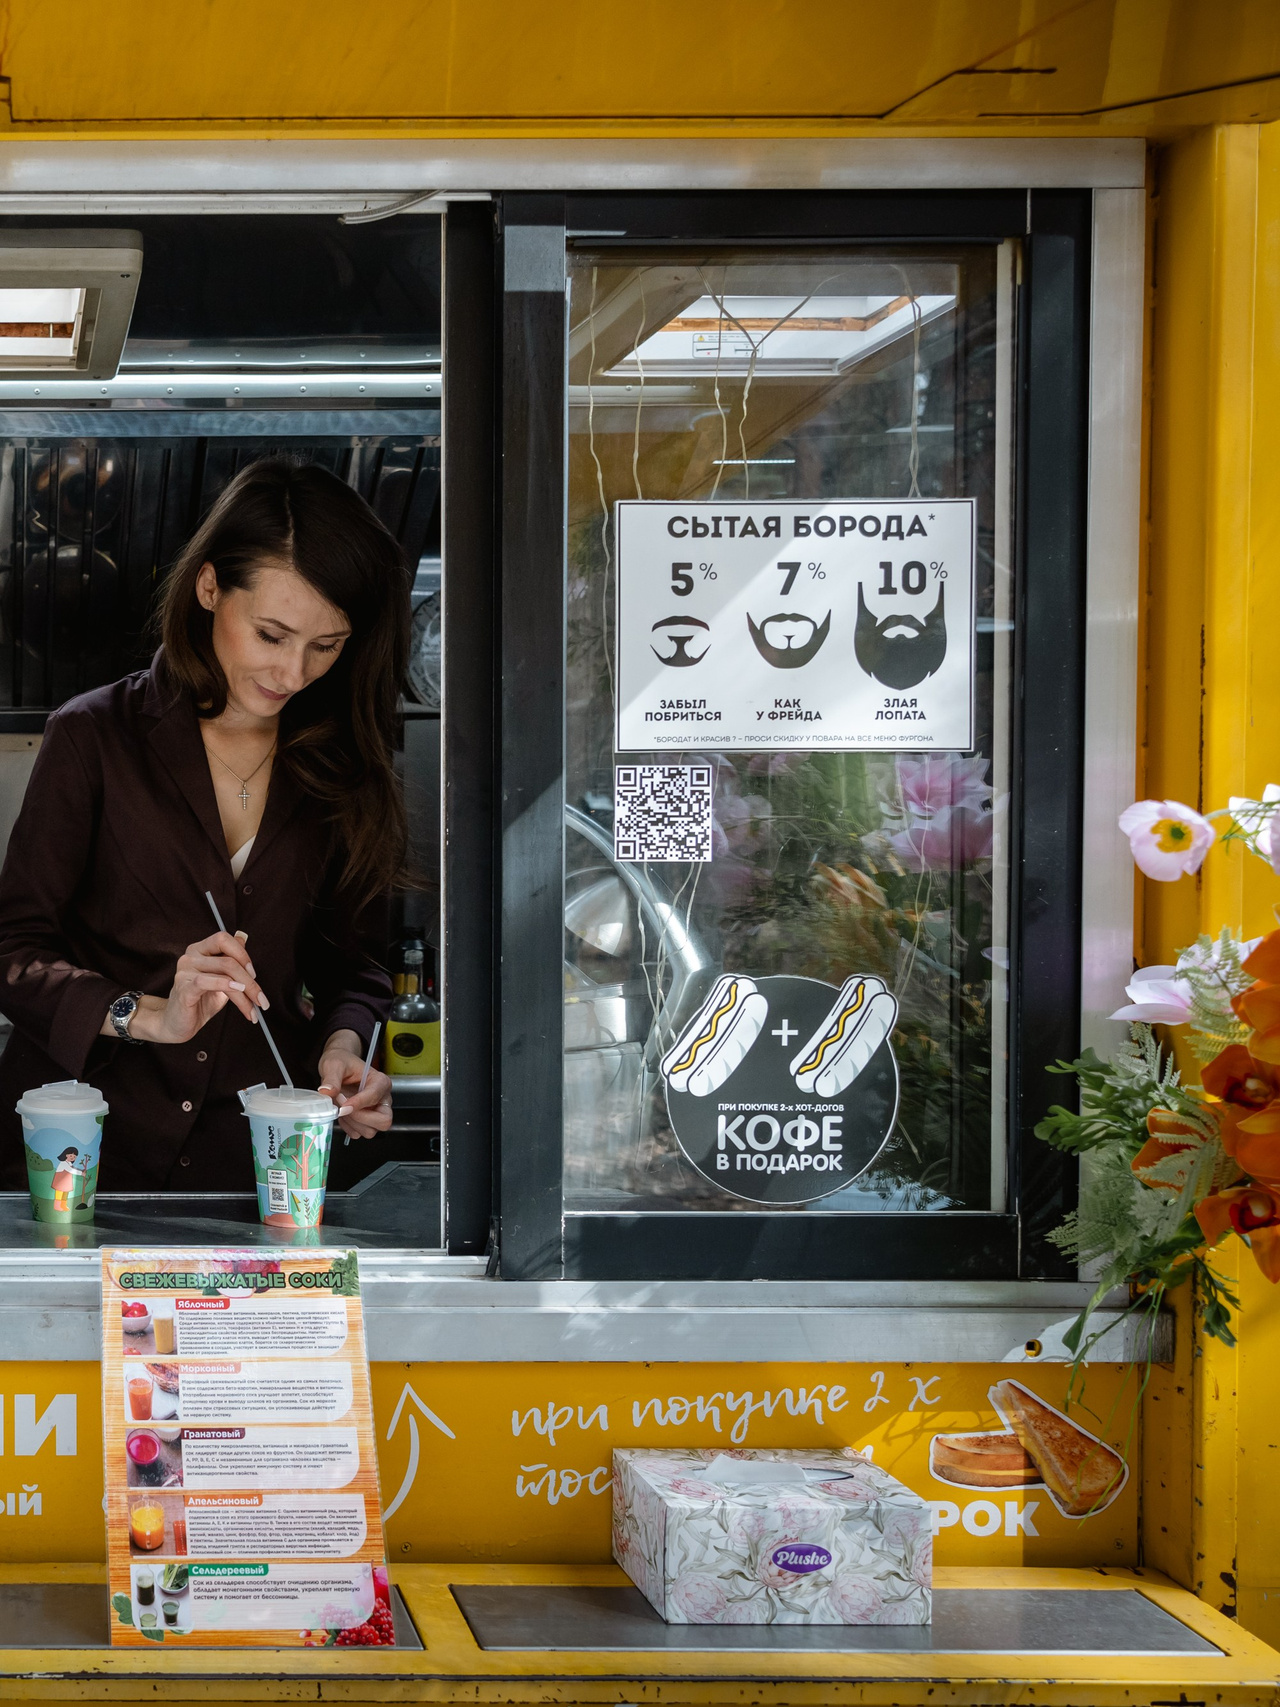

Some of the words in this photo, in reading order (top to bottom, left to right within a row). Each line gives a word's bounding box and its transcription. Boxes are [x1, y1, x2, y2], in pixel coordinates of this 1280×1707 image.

[668, 515, 781, 538] СЫТАЯ
[878, 561, 948, 595] 10%
[660, 700, 706, 709] ЗАБЫЛ
[774, 699, 800, 708] КАК
[884, 699, 917, 708] ЗЛАЯ
[645, 712, 721, 721] ПОБРИТЬСЯ
[756, 712, 765, 721] У
[768, 710, 822, 721] ФРЕЙДА
[875, 711, 926, 721] ЛОПАТА
[773, 735, 804, 743] СКИДКУ
[795, 1104, 844, 1113] ХОТ-ДОГОВ
[718, 1114, 843, 1151] КОФЕ
[717, 1154, 729, 1170] В
[736, 1154, 843, 1174] ПОДАРОК
[120, 1271, 286, 1289] СВЕЖЕВЫЖАТЫЕ
[288, 1271, 343, 1288] СОКИ
[178, 1300, 224, 1309] Яблочный
[181, 1364, 235, 1374] Морковный
[512, 1402, 608, 1446] при
[633, 1384, 849, 1443] покупке
[184, 1429, 240, 1440] Гранатовый
[188, 1496, 258, 1506] Апельсиновый
[777, 1551, 828, 1564] Plushe
[192, 1566, 264, 1575] Сельдереевый
